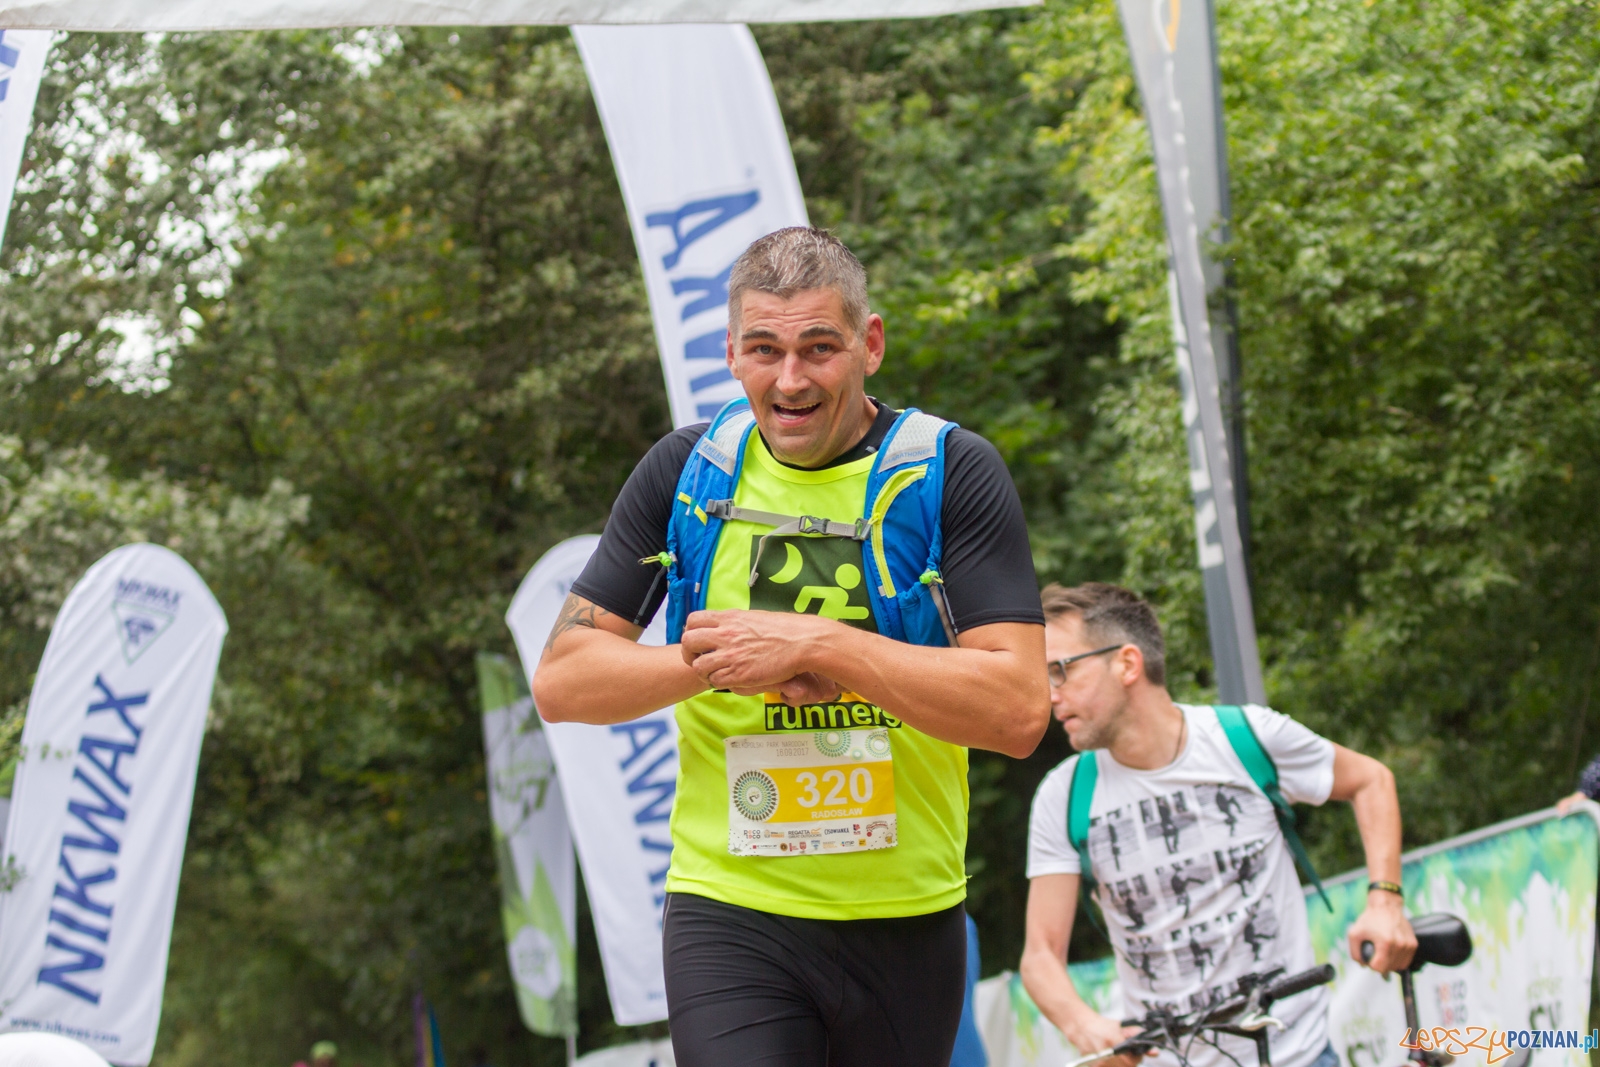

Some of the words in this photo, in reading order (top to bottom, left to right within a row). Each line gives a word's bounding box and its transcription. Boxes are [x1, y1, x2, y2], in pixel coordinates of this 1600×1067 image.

[796, 767, 874, 808] 320
[811, 807, 863, 820] RADOSŁAW
[37, 673, 150, 1006] NIKWAX
